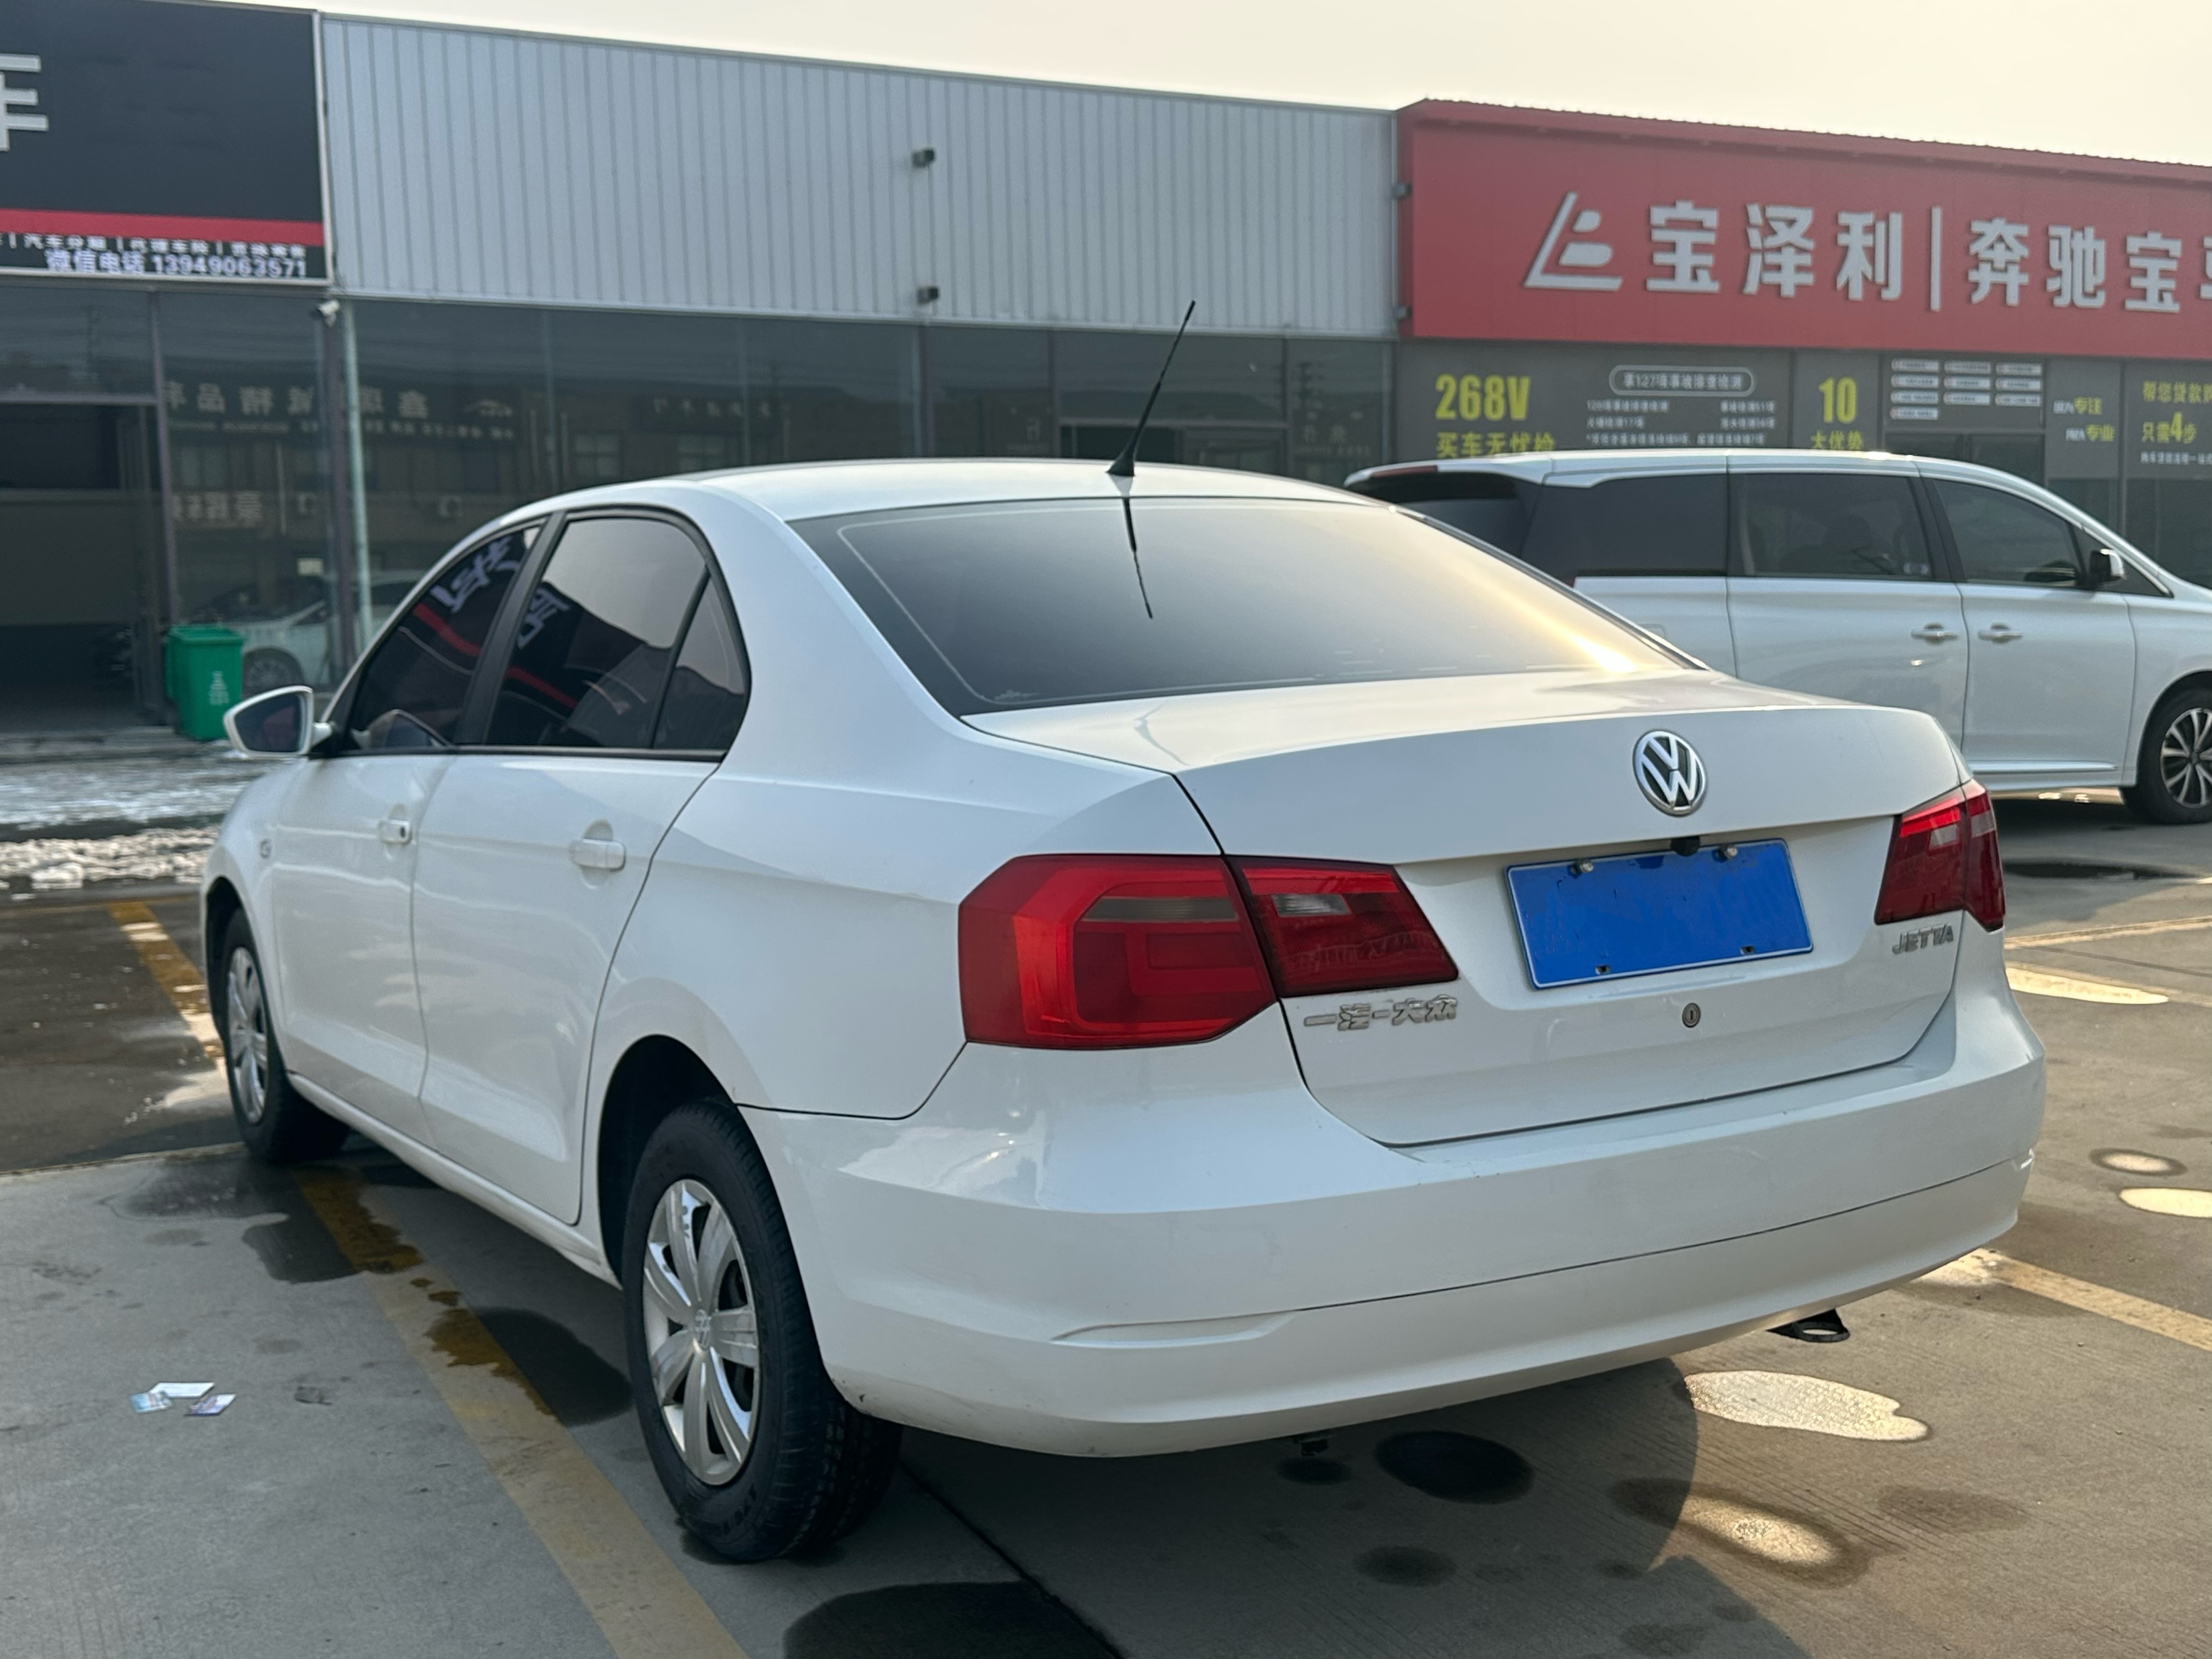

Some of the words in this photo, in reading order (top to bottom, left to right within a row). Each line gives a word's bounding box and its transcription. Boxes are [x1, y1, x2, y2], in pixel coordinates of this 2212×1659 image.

[152, 253, 307, 278] 13949063571
[1646, 201, 1903, 301] 宝泽利
[1967, 217, 2212, 313] 奔驰宝
[1435, 374, 1531, 421] 268V
[1819, 377, 1858, 424] 10
[1635, 730, 1705, 813] VW
[1892, 922, 1954, 955] JETTA
[1303, 993, 1458, 1031] 一汽-大众
